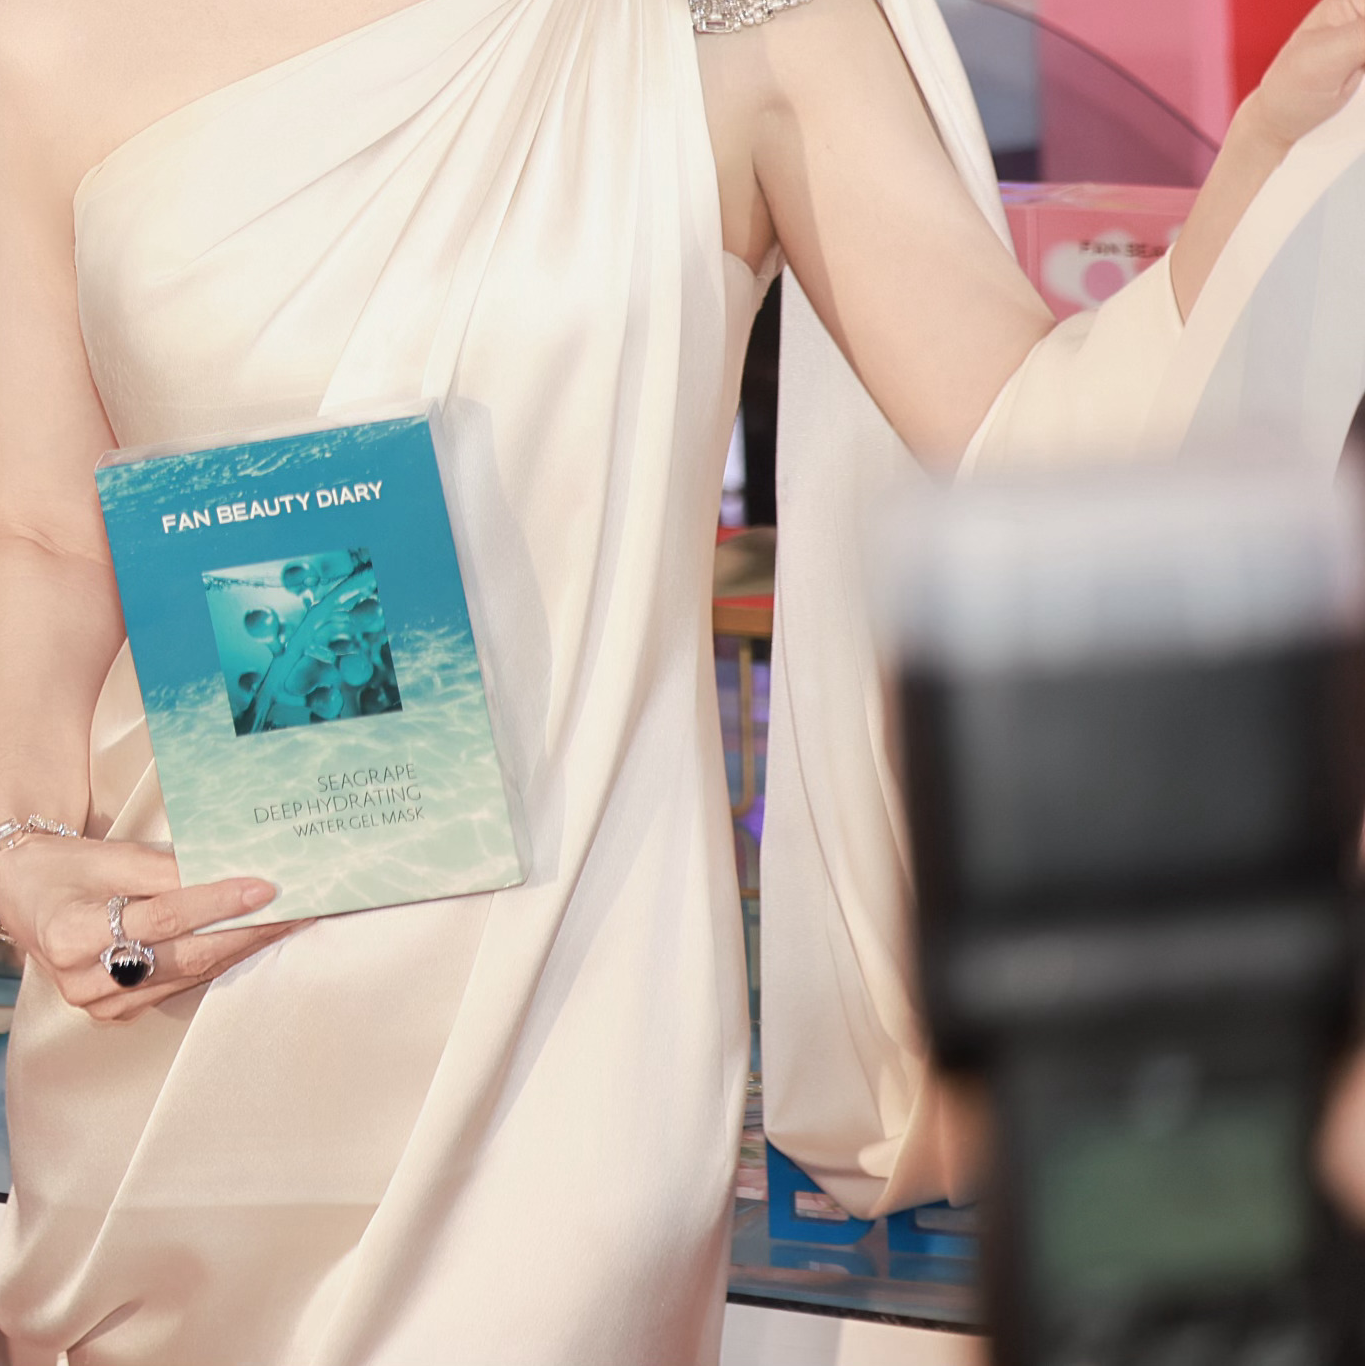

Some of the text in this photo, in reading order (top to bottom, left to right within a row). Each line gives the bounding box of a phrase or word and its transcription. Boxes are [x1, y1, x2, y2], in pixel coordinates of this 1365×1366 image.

[161, 480, 382, 534] FAN BEAUTY DIARY
[317, 763, 417, 793] SEAGRAPE
[253, 784, 422, 824] DEEP HYDRATING
[293, 806, 425, 838] WATER GEL MASK
